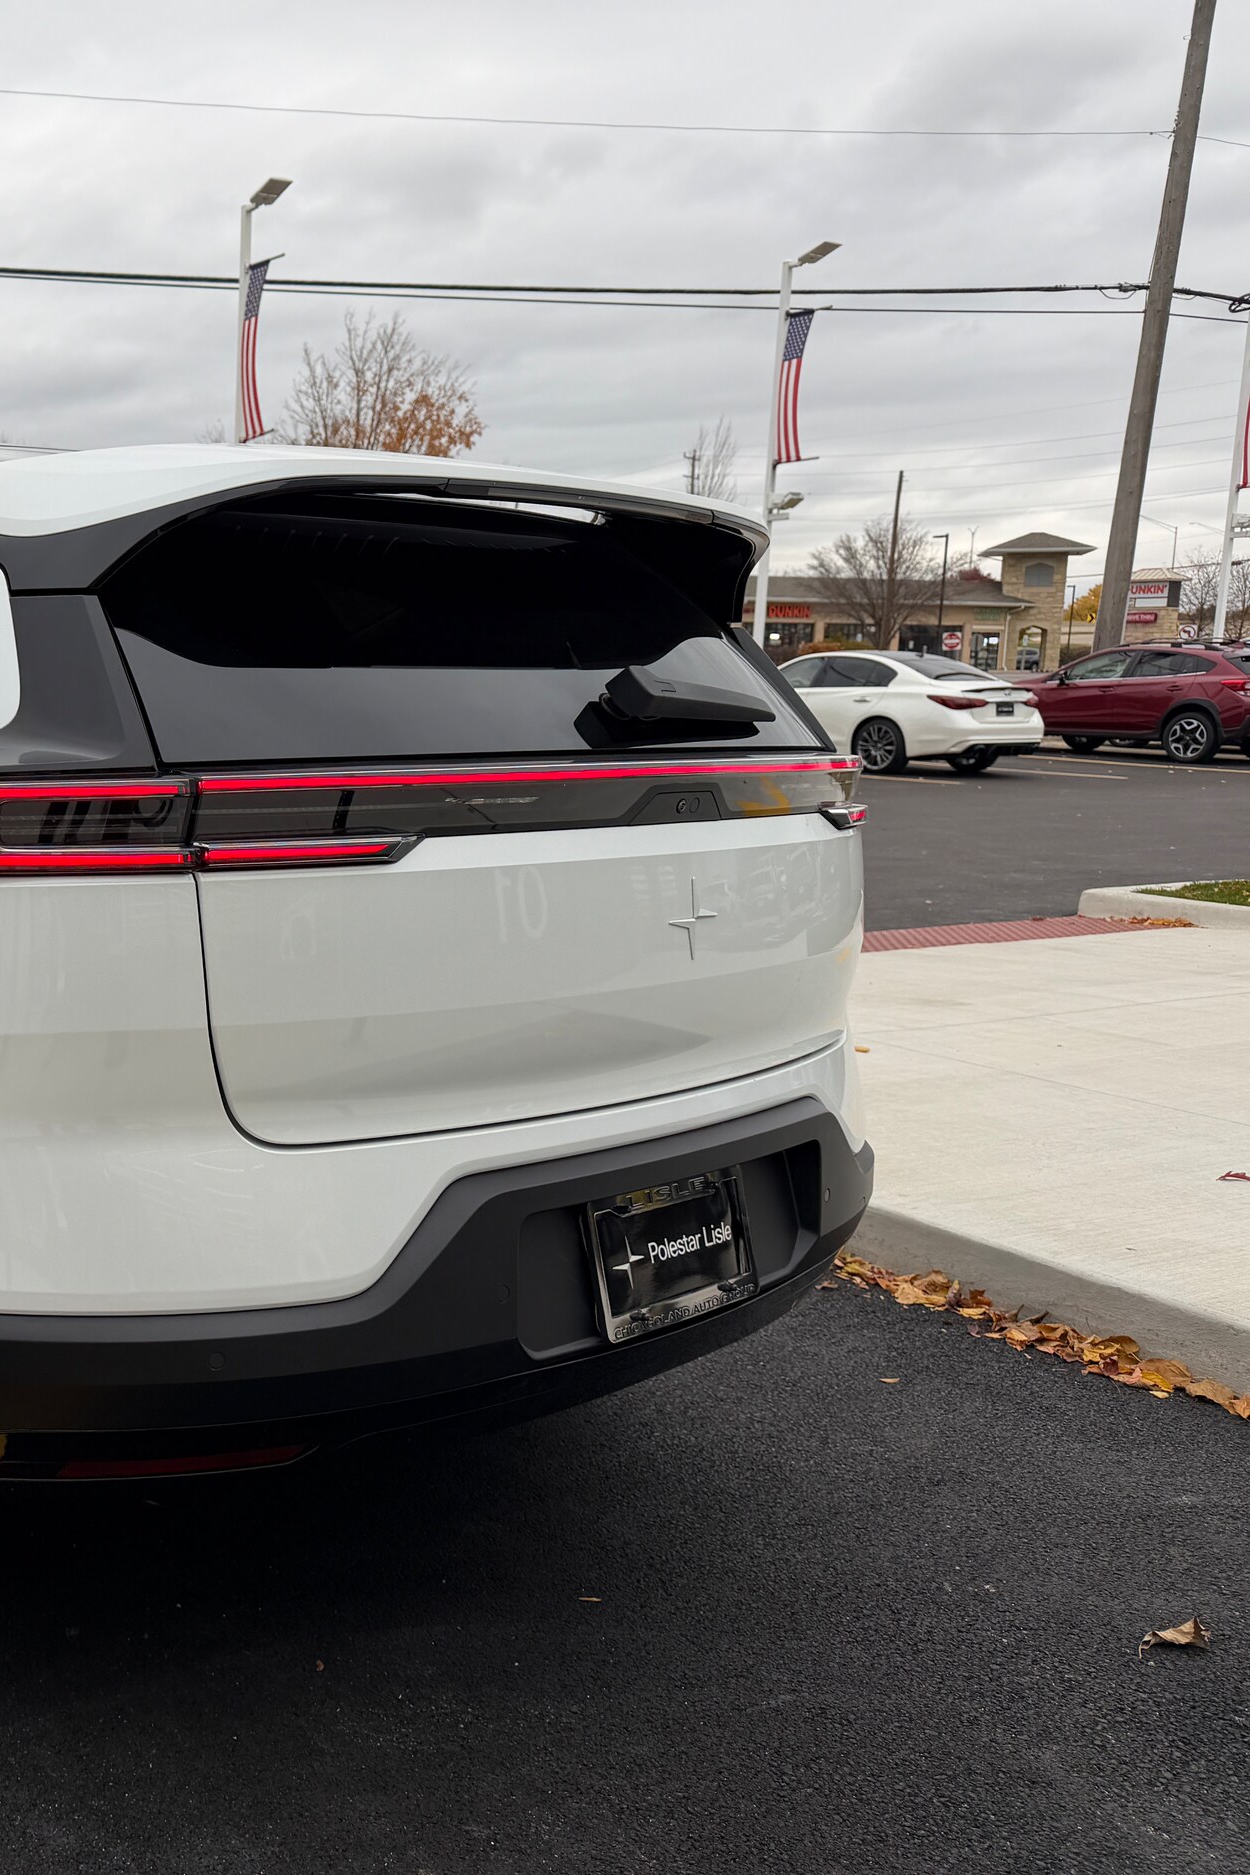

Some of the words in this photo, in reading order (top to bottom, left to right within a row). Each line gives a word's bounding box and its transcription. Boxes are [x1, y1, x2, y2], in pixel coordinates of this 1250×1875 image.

[1130, 584, 1167, 595] UNKIN'
[626, 1176, 705, 1210] LISLE
[647, 1233, 702, 1264] Polestar
[702, 1221, 732, 1247] Lisle
[692, 1295, 720, 1314] AUTO
